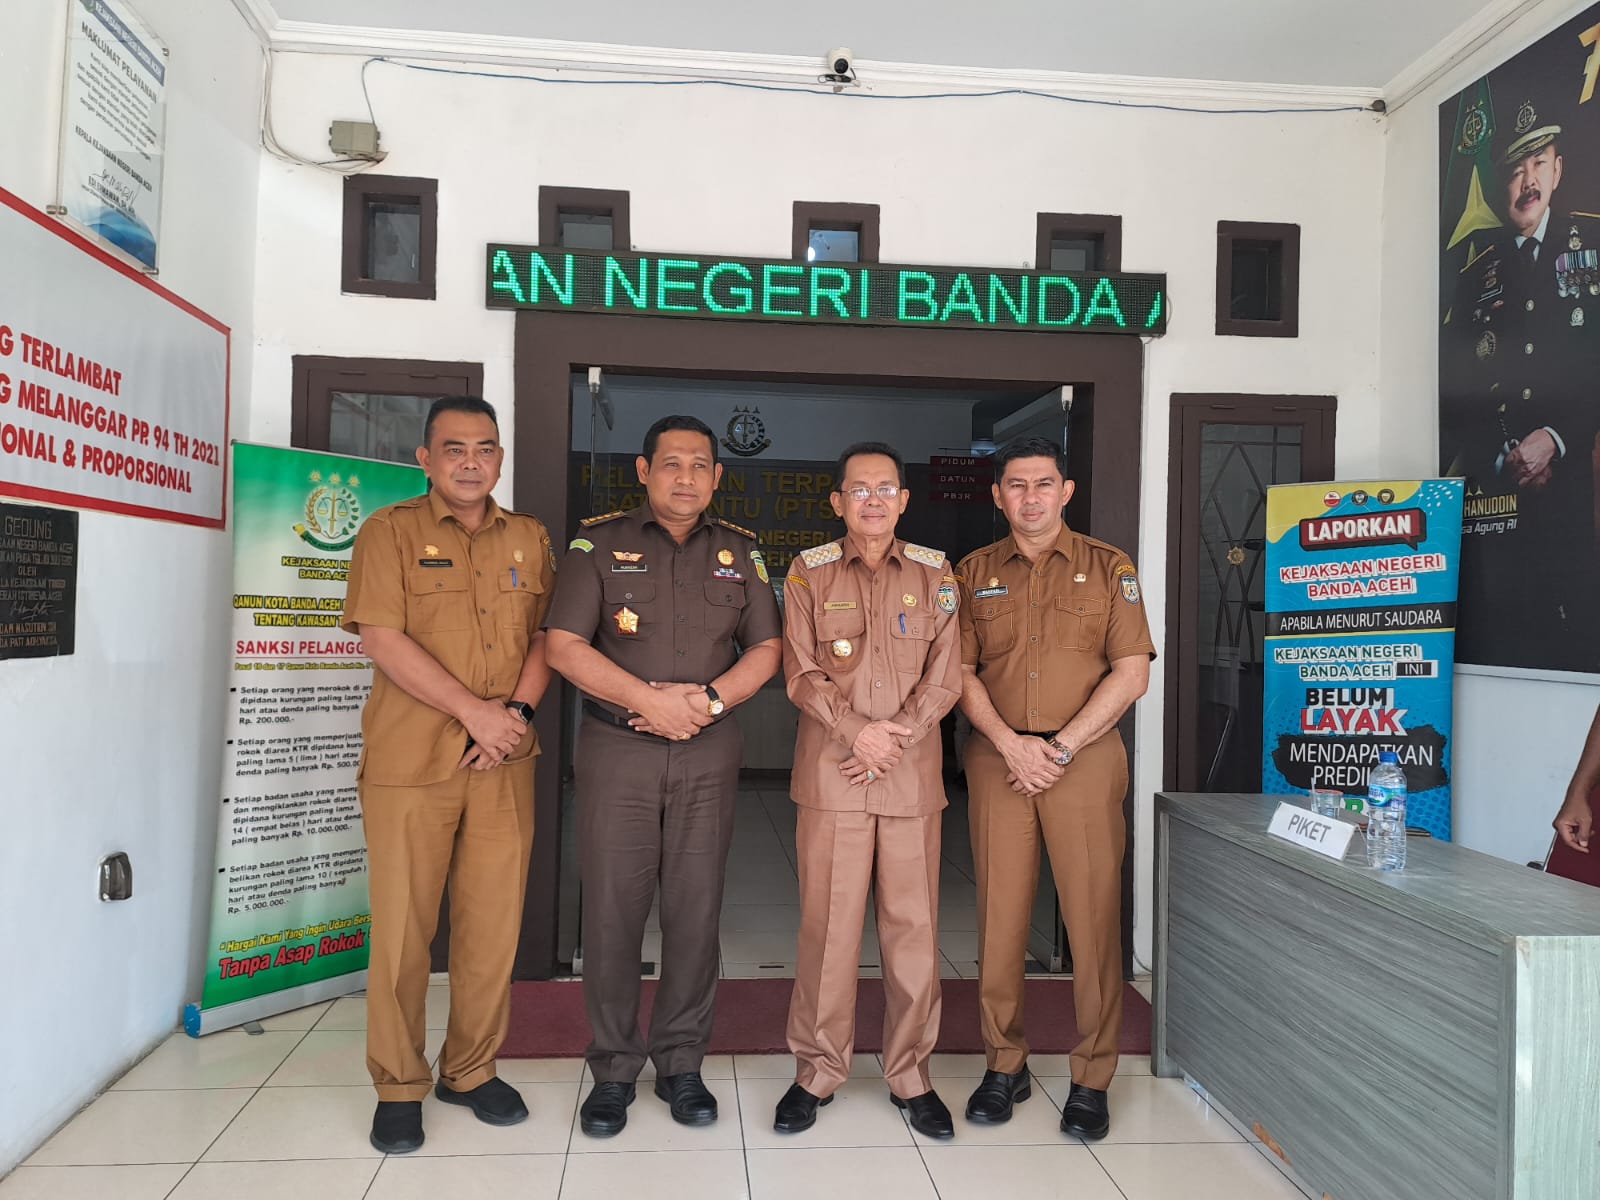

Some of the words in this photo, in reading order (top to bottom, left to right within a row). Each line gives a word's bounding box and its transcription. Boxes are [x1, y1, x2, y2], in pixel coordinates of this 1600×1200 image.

[82, 21, 120, 66] MAKLUMAT
[122, 60, 156, 104] PELAYANAN
[605, 255, 868, 318] NEGERI
[898, 269, 1127, 327] BANDA
[20, 332, 122, 397] TERLAMBAT
[17, 380, 128, 440] MELANGGAR
[131, 418, 149, 446] PP.
[153, 425, 170, 452] 94
[173, 431, 189, 458] TH
[191, 438, 220, 467] 2021
[62, 439, 77, 468] &
[82, 444, 192, 494] PROPORSIONAL
[760, 471, 836, 495] TERP
[1308, 514, 1412, 542] LAPORKAN
[1474, 522, 1504, 536] Agung
[282, 556, 339, 569] KEJAKSAAN
[1280, 560, 1373, 580] KEJAKSAAN
[1377, 554, 1441, 573] NEGERI
[299, 569, 332, 580] BANDA
[1309, 581, 1362, 598] BANDA
[1366, 577, 1412, 594] ACEH
[233, 595, 262, 608] QANUN
[264, 596, 289, 609] KOTA
[291, 597, 317, 610] BANDA
[319, 598, 341, 611] ACEH
[254, 613, 295, 626] TENTANG
[296, 615, 336, 627] KAWASAN
[1280, 615, 1324, 632] APABILA
[1326, 612, 1383, 629] MENURUT
[1384, 609, 1443, 627] SAUDARA
[236, 640, 294, 655] SANKSI
[1275, 647, 1358, 661] KEJAKSAAN
[1362, 645, 1418, 658] NEGERI
[1300, 664, 1350, 678] BANDA
[1352, 663, 1391, 677] ACEH
[1404, 663, 1424, 676] INI
[240, 686, 268, 694] Setiap
[296, 686, 315, 694] yang
[1305, 688, 1388, 706] BELUM
[239, 696, 277, 705] dipidana
[279, 695, 315, 704] kurungan
[317, 694, 342, 702] paling
[305, 704, 330, 712] paling
[332, 703, 359, 712] banyak
[238, 717, 252, 725] Rp.
[256, 715, 294, 724] 200.000.-
[1301, 709, 1402, 733] LAYAK
[236, 747, 261, 756] rokok
[263, 745, 290, 754] diarea
[310, 743, 344, 752] dipidana
[237, 738, 266, 746] Setiap
[293, 736, 311, 744] yang
[235, 767, 262, 776] denda
[264, 766, 290, 775] paling
[291, 763, 318, 772] banyak
[320, 762, 334, 770] Rp.
[236, 758, 263, 767] paling
[288, 755, 294, 763] 5
[233, 795, 262, 804] Setiap
[315, 788, 334, 797] yang
[233, 806, 249, 814] dan
[251, 801, 308, 812] mengiklankan
[309, 798, 332, 806] rokok
[333, 796, 357, 804] diarea
[271, 810, 307, 820] kurungan
[308, 807, 334, 816] paling
[232, 826, 242, 834] 14
[250, 823, 277, 832] empat
[279, 820, 300, 829] belas
[306, 817, 322, 825] hari
[324, 816, 342, 824] atau
[1287, 814, 1332, 844] PIKET
[231, 836, 258, 846] paling
[260, 832, 289, 841] banyak
[228, 873, 260, 883] belikan
[262, 869, 285, 878] rokok
[287, 865, 311, 874] diarea
[313, 861, 330, 869] KTR
[332, 857, 363, 867] dipidana
[229, 864, 258, 872] Setiap
[259, 860, 284, 868] badan
[286, 855, 308, 864] usaha
[310, 853, 330, 862] yang
[228, 882, 268, 893] kurungan
[269, 879, 294, 888] paling
[295, 874, 315, 882] lama
[228, 895, 244, 905] hari
[247, 892, 266, 901] atau
[267, 887, 292, 898] denda
[292, 884, 317, 894] paling
[227, 906, 240, 914] Rp.
[226, 936, 257, 953] Hargai
[259, 931, 283, 946] Kami
[284, 928, 304, 940] Yang
[306, 924, 326, 936] Ingin
[328, 918, 352, 931] Udara
[220, 955, 271, 979] Tanpa
[274, 944, 315, 966] Asap
[318, 928, 366, 957] Rokok
